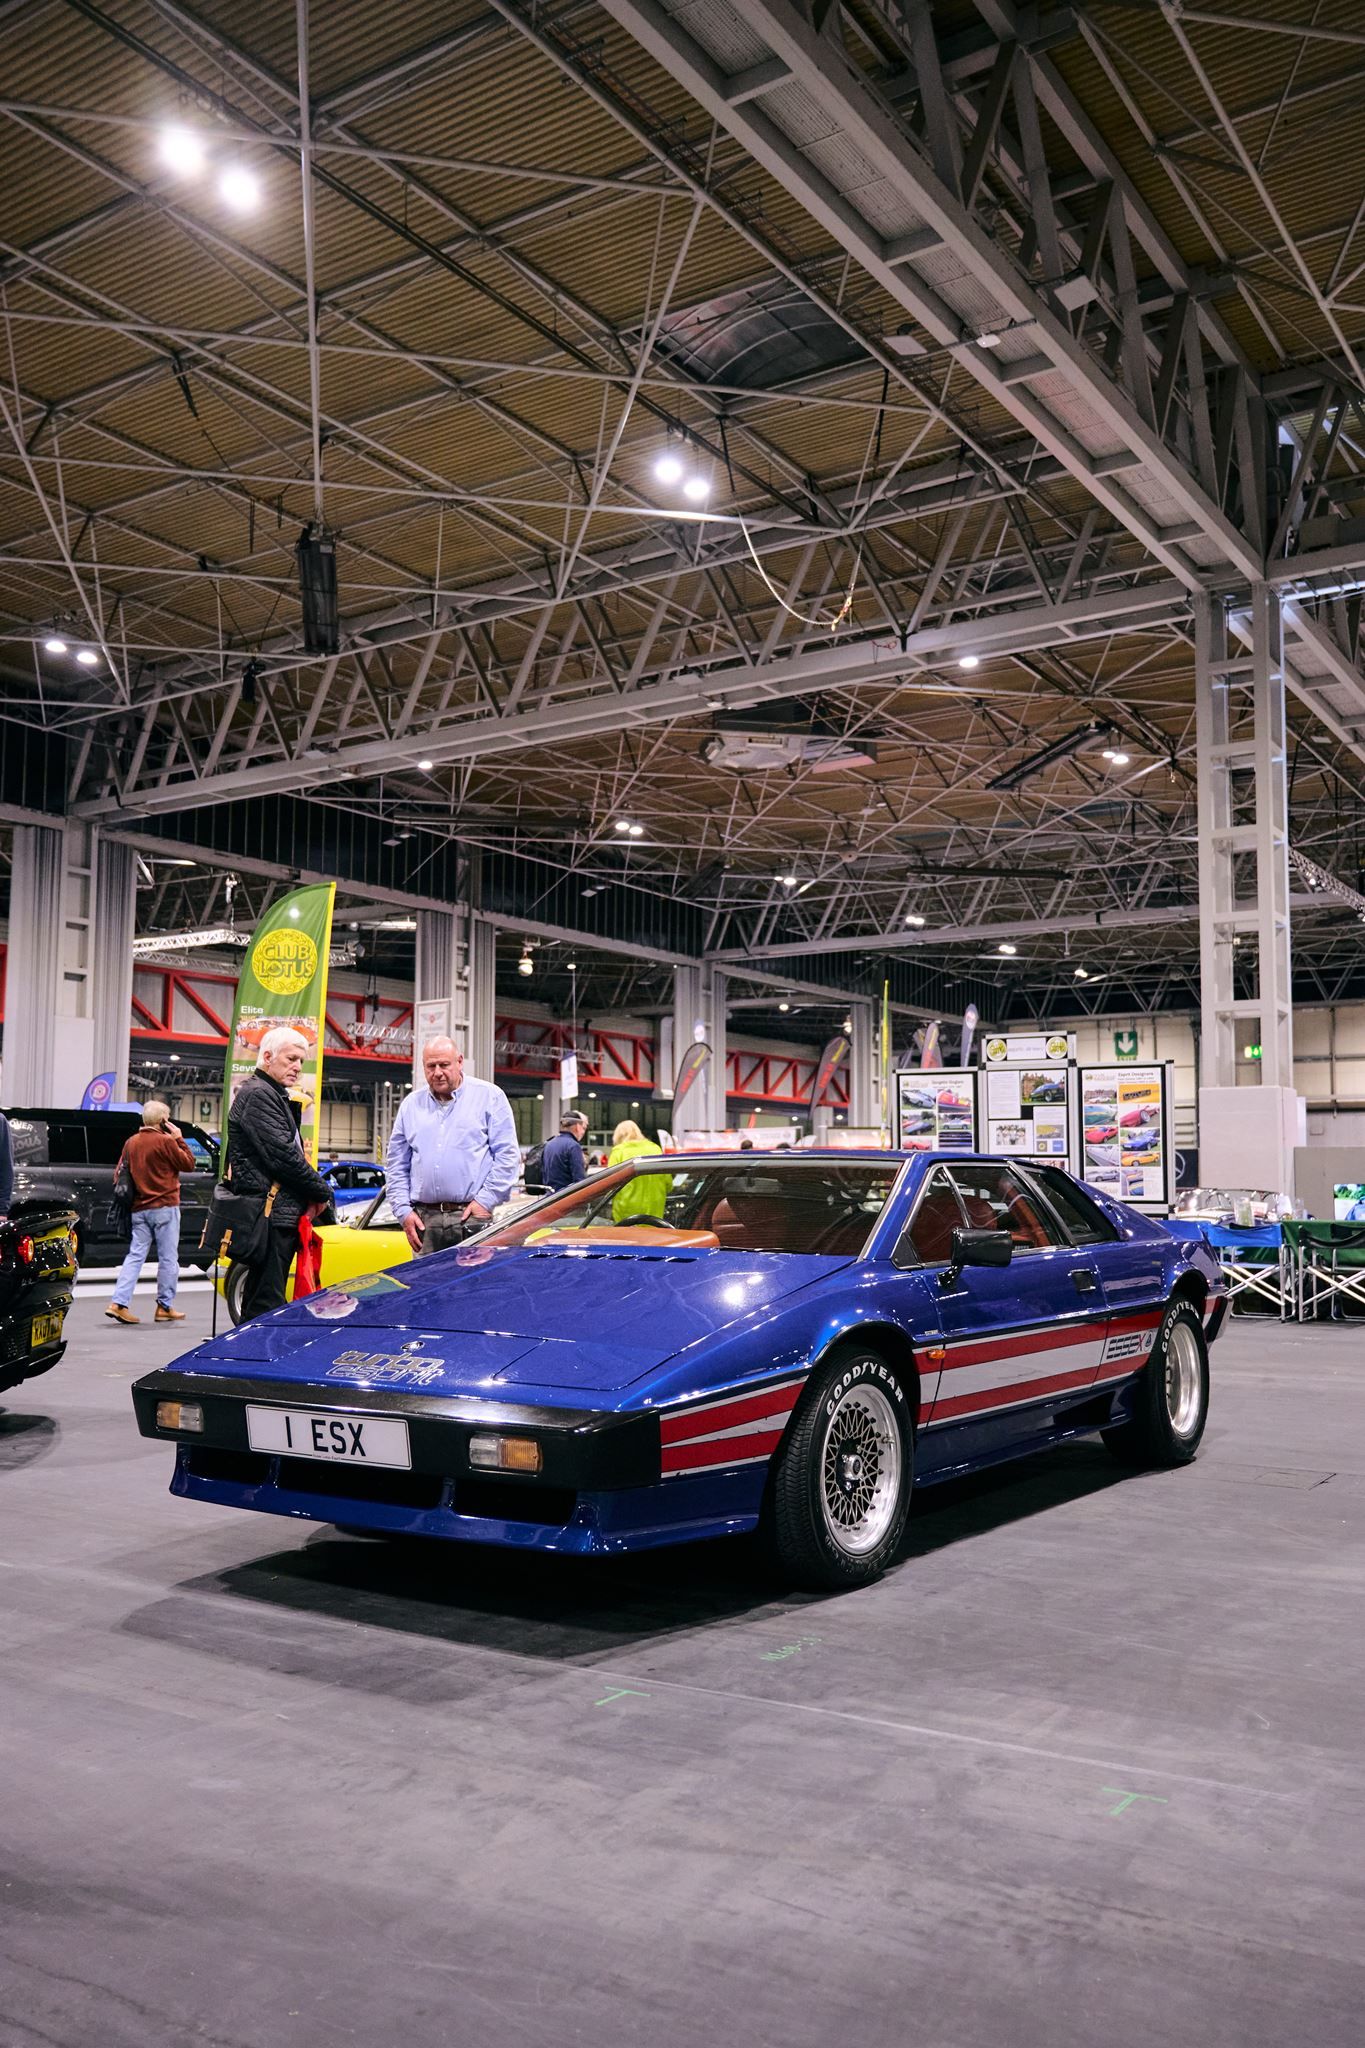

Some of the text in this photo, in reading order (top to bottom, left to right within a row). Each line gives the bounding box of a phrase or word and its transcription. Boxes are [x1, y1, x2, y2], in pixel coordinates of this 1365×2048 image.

[263, 945, 310, 961] CLUB
[259, 961, 314, 978] LOTUS
[240, 1005, 264, 1014] Elite
[231, 1063, 256, 1073] Seve
[1106, 1333, 1147, 1360] ESSEX
[826, 1362, 904, 1416] GOODYEAR
[310, 1418, 367, 1457] ESX
